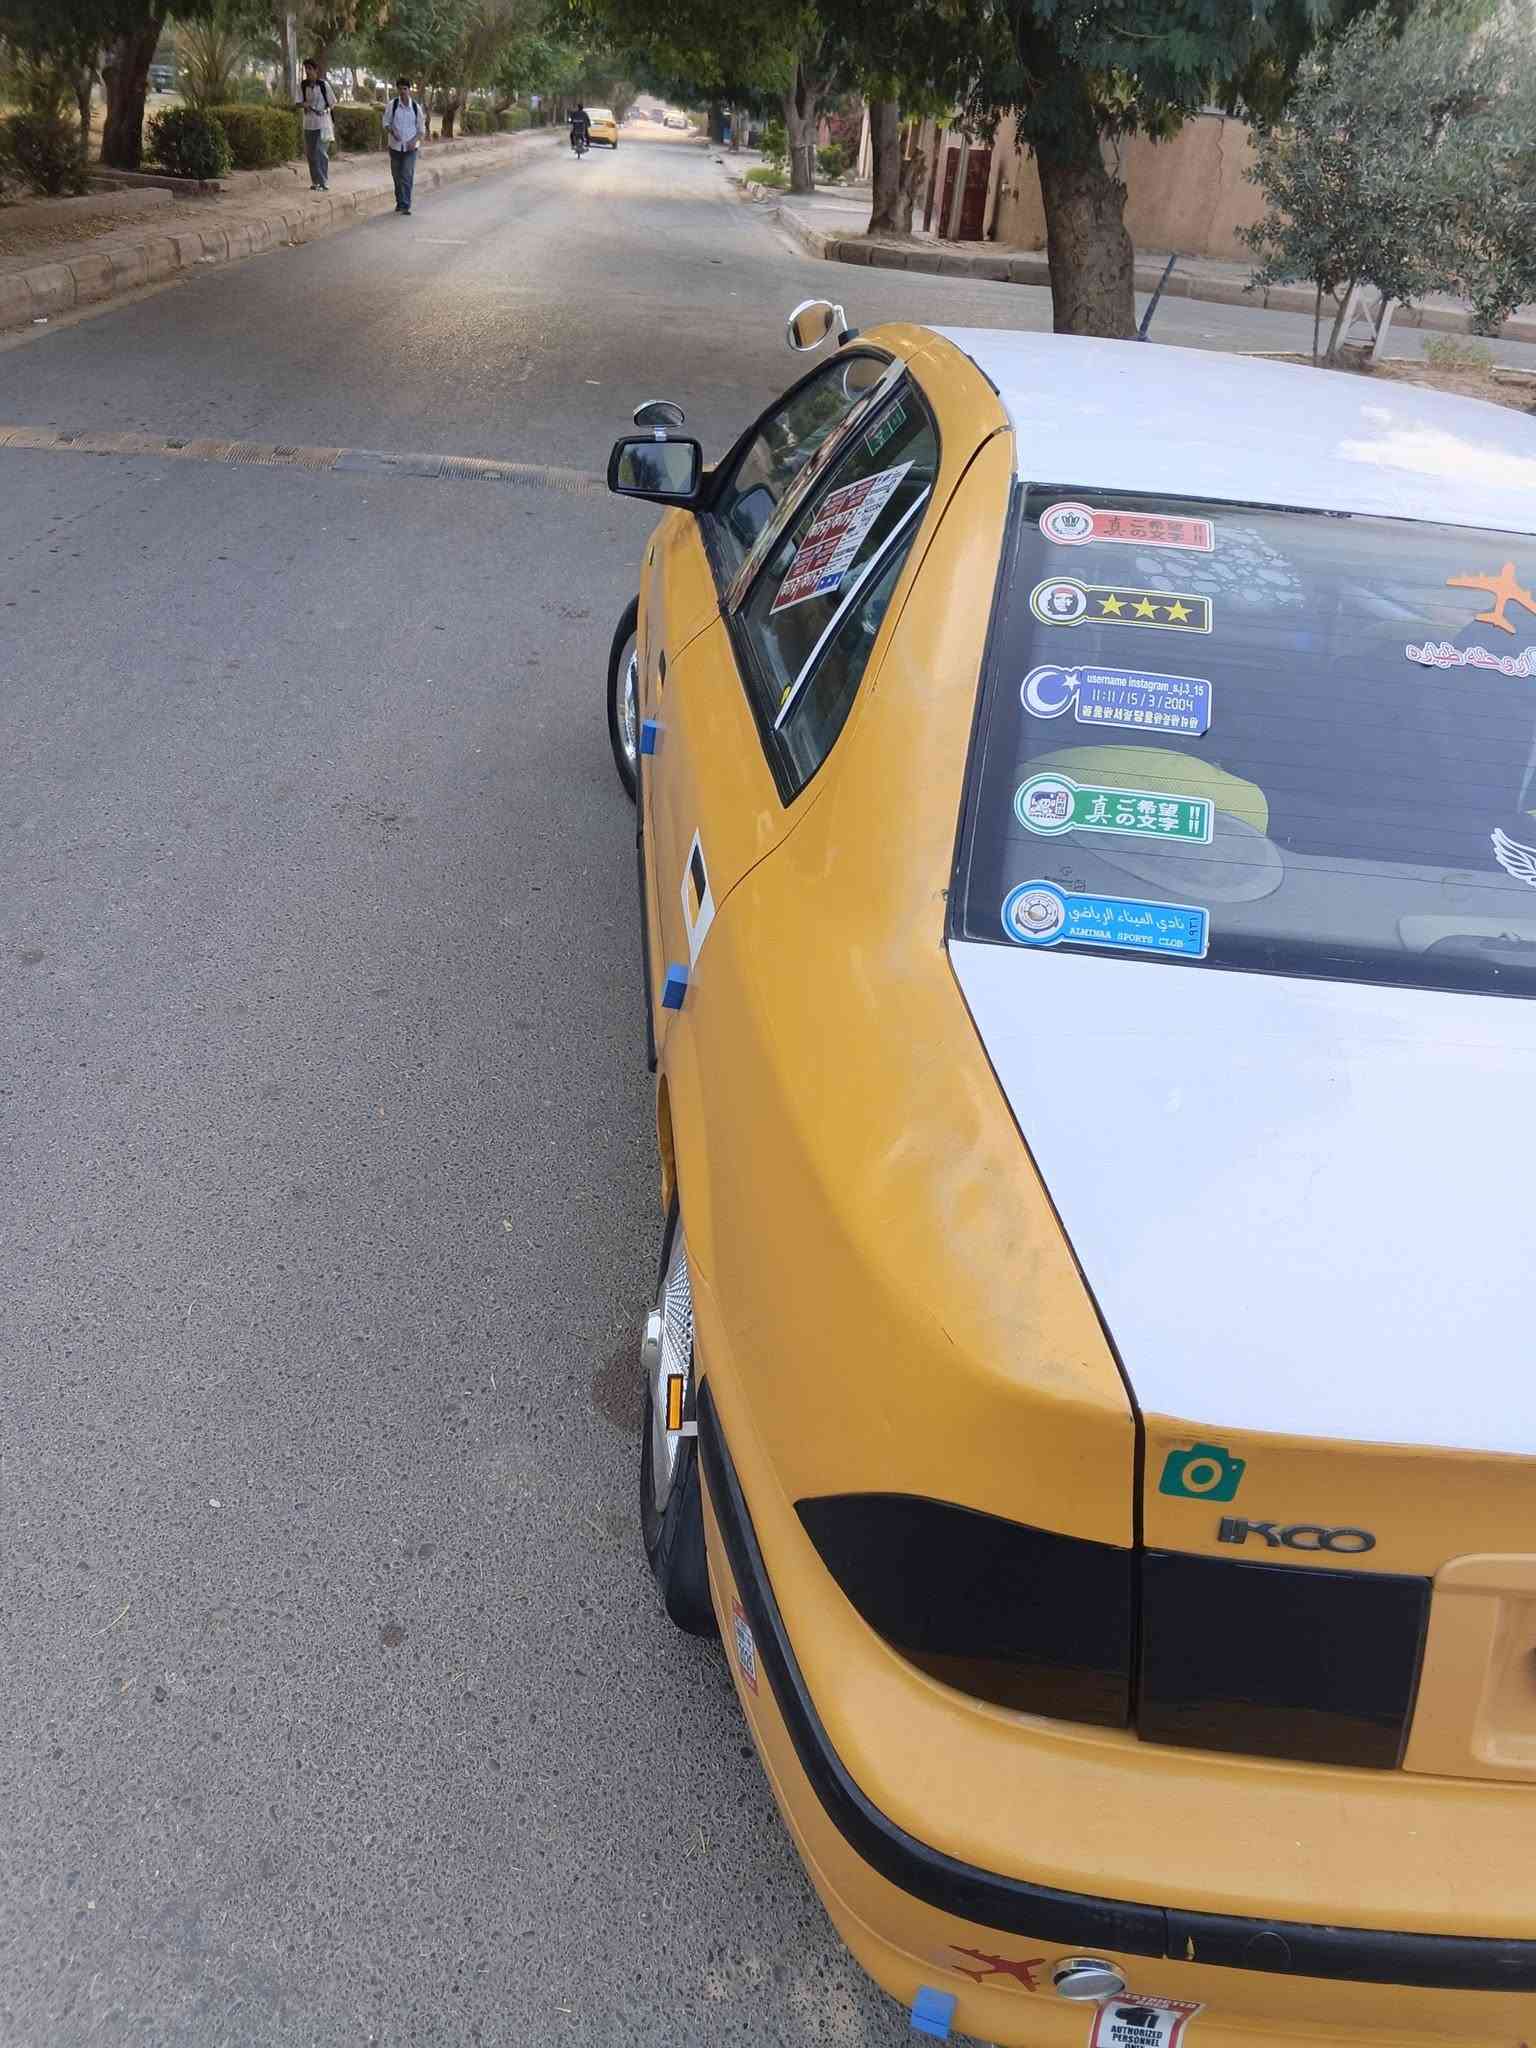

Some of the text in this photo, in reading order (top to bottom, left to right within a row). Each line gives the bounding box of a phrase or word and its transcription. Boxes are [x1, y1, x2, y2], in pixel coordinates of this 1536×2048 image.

[1069, 906, 1184, 932] نادي الميناء الرياضي
[1111, 2025, 1163, 2039] AUTHORIZED
[1112, 2034, 1160, 2047] PERSONNEL
